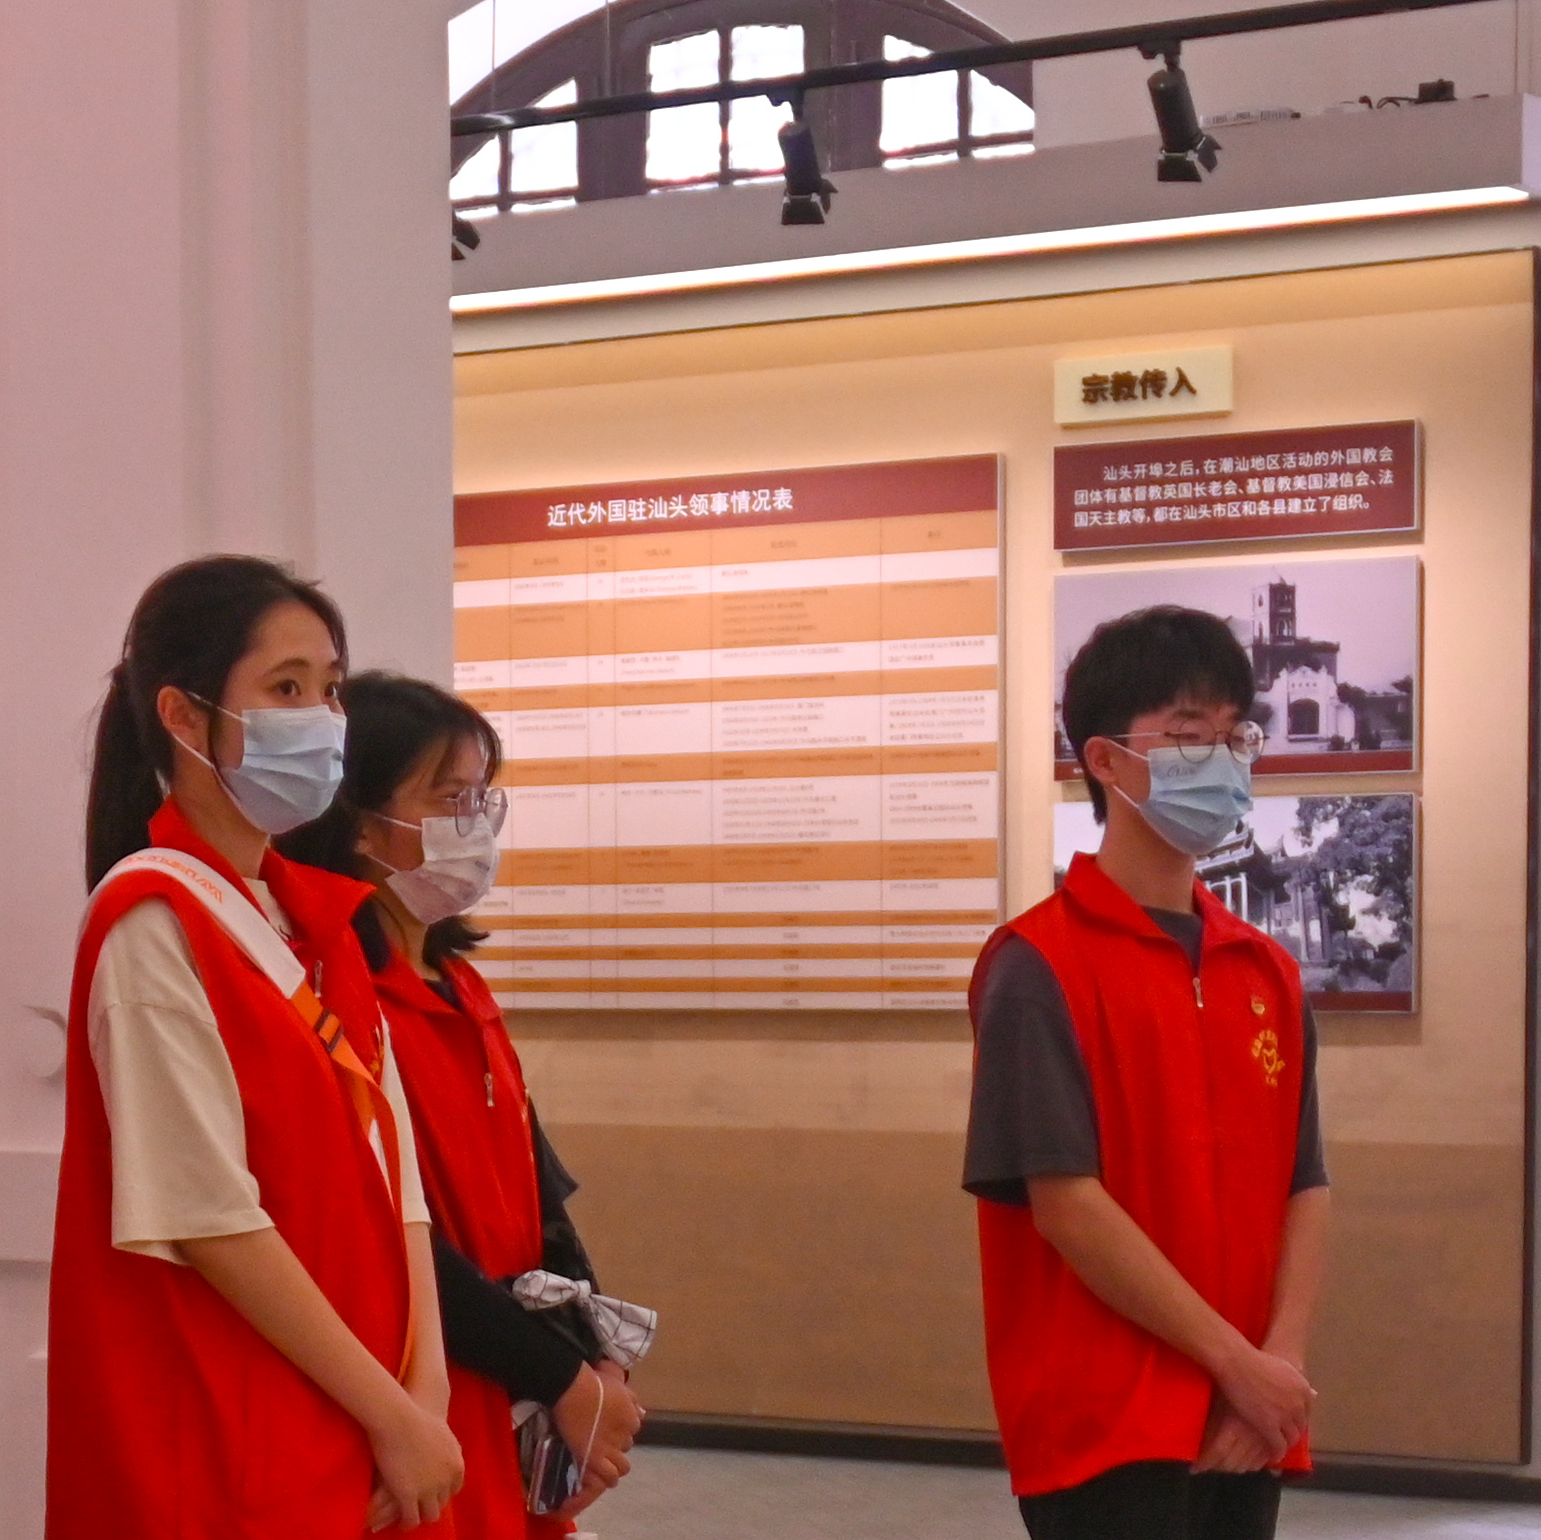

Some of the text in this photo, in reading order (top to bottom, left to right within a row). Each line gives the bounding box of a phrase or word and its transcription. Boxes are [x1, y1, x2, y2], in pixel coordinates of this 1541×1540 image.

[1081, 366, 1197, 404] 宗教传入
[1103, 446, 1393, 481] 汕头开埠之后,在潮汕地区活动的外国教会
[1074, 469, 1394, 506] 团体有基督教英国长老会、基督教美国浸信会、法
[547, 487, 794, 528] 近代外国驻汕头领事情况表
[1074, 494, 1370, 528] 国天主教等,都在汕头市区和各县建立了组织。
